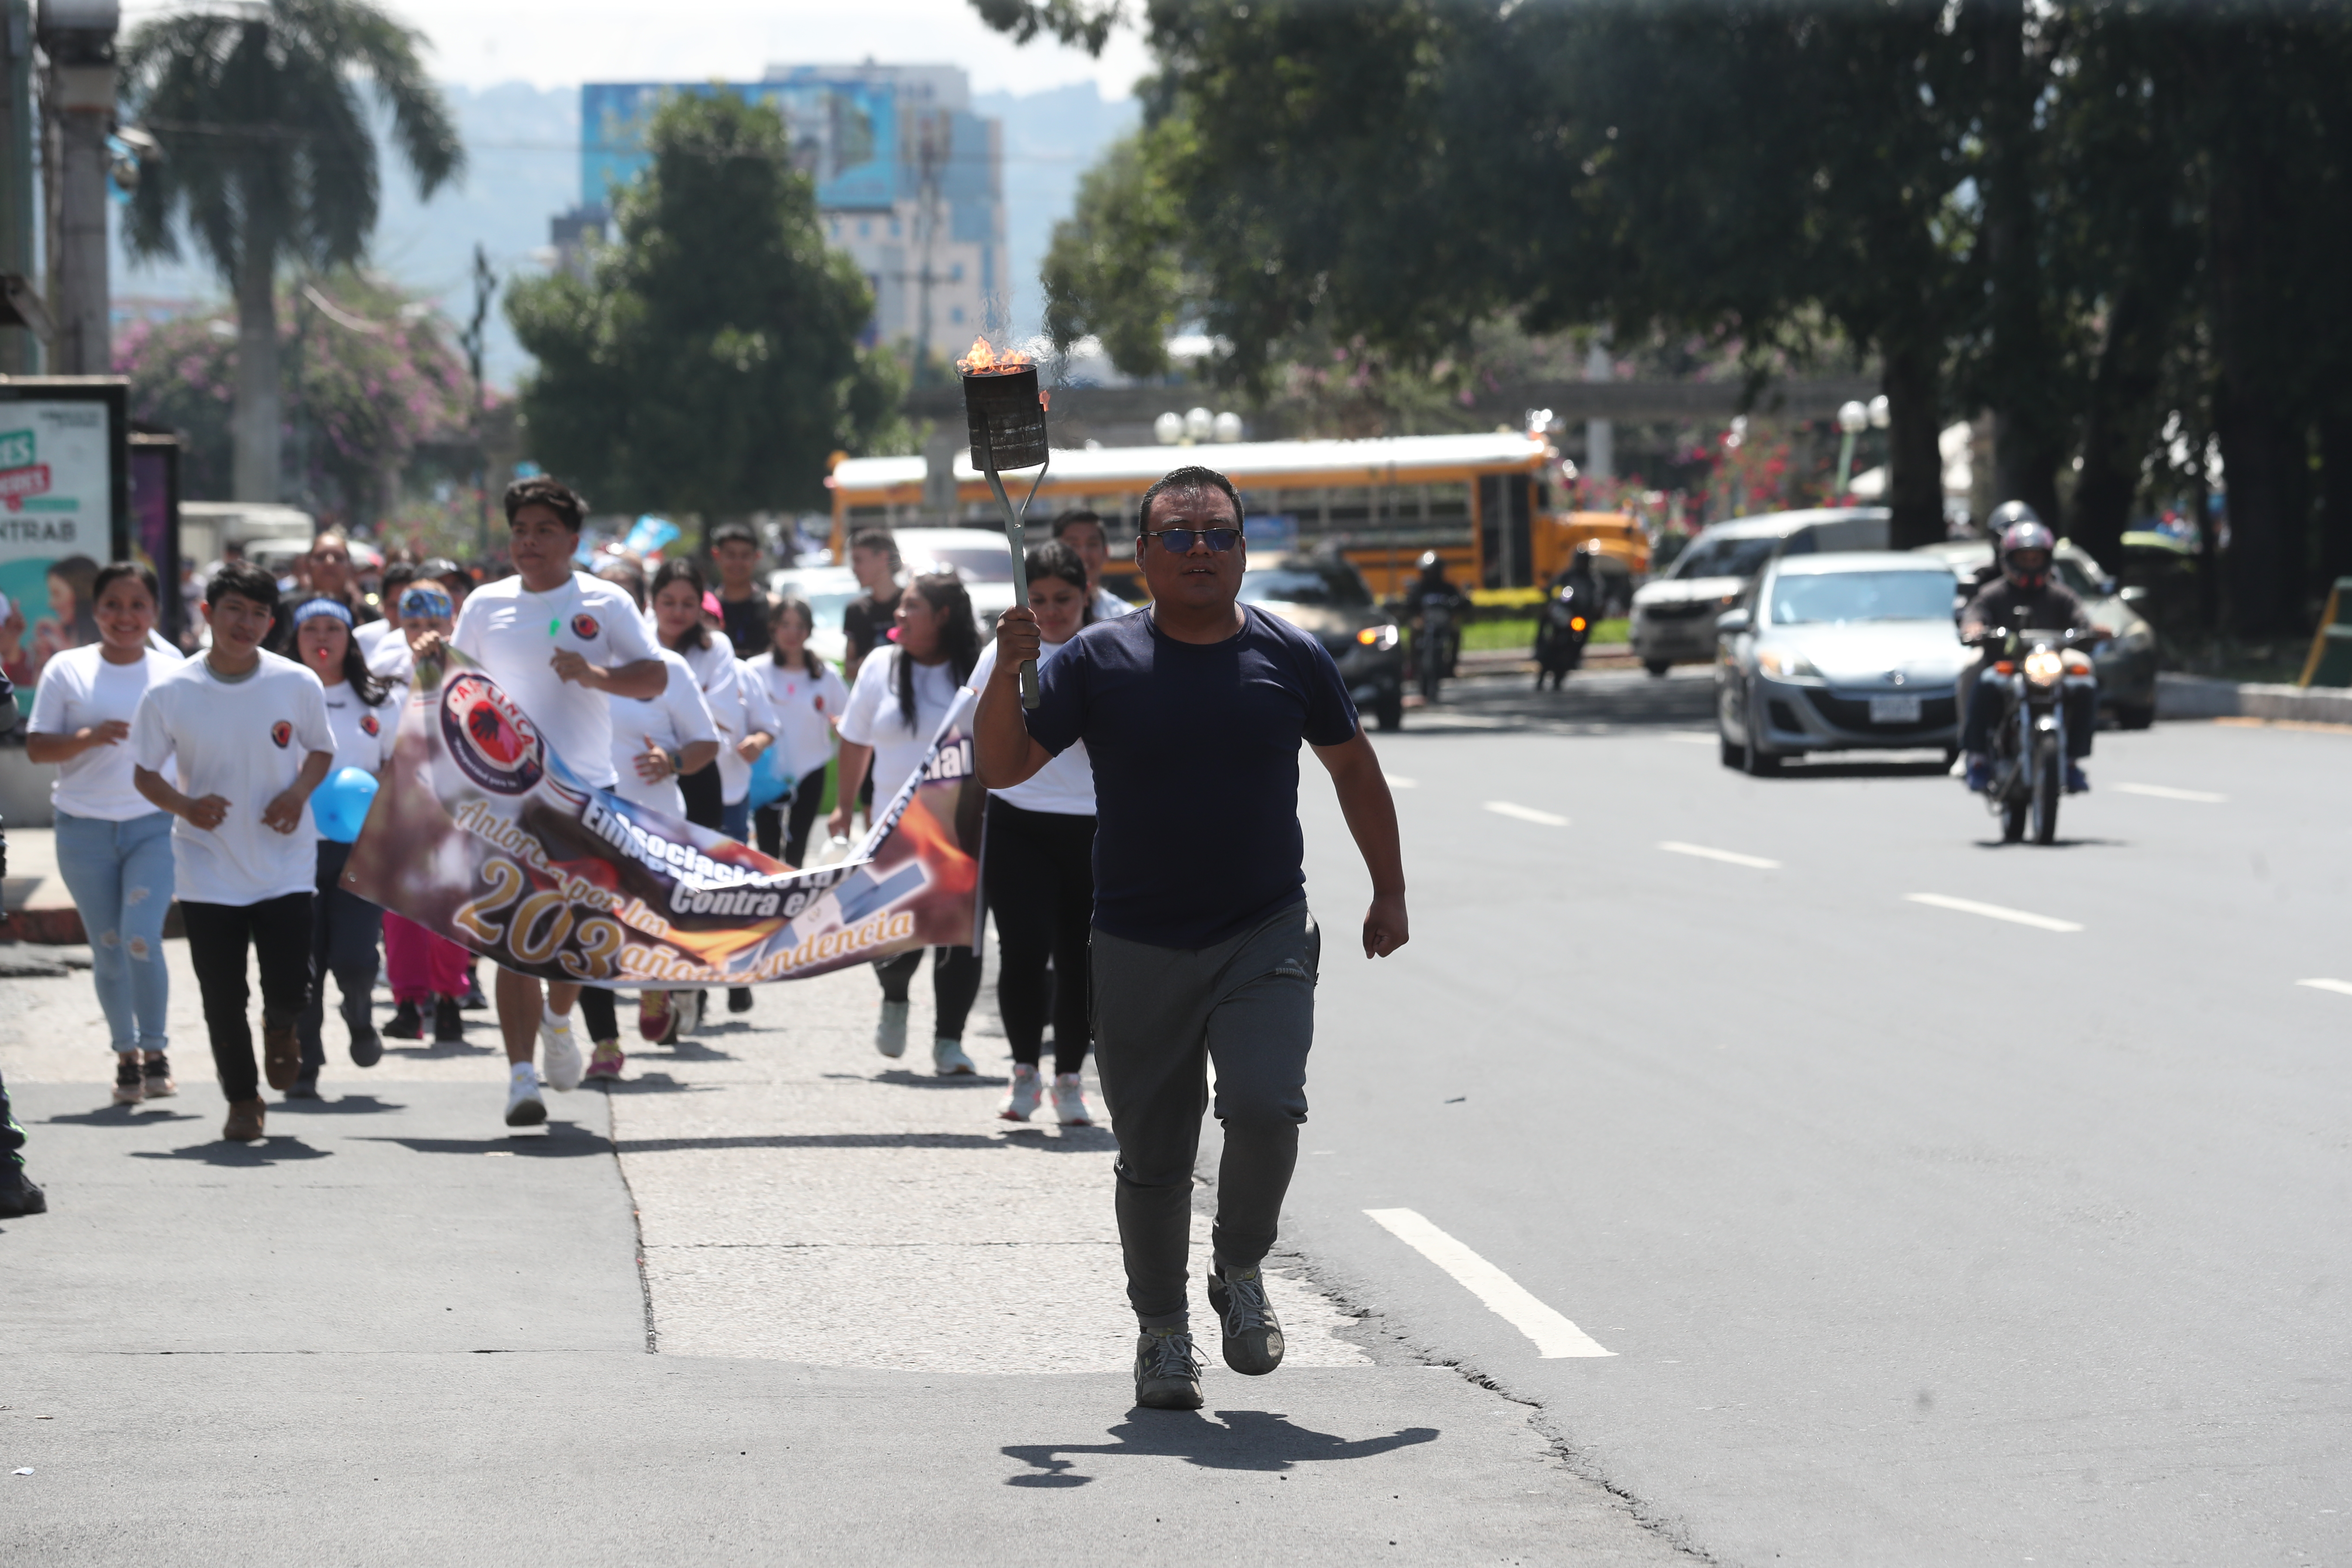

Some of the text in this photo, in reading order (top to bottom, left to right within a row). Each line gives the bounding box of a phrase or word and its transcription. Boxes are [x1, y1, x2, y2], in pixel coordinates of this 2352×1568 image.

[456, 678, 535, 744] ALINCA
[456, 800, 567, 883] Antorca
[568, 879, 623, 909] por
[454, 858, 623, 980] 203
[669, 882, 781, 916] Contra
